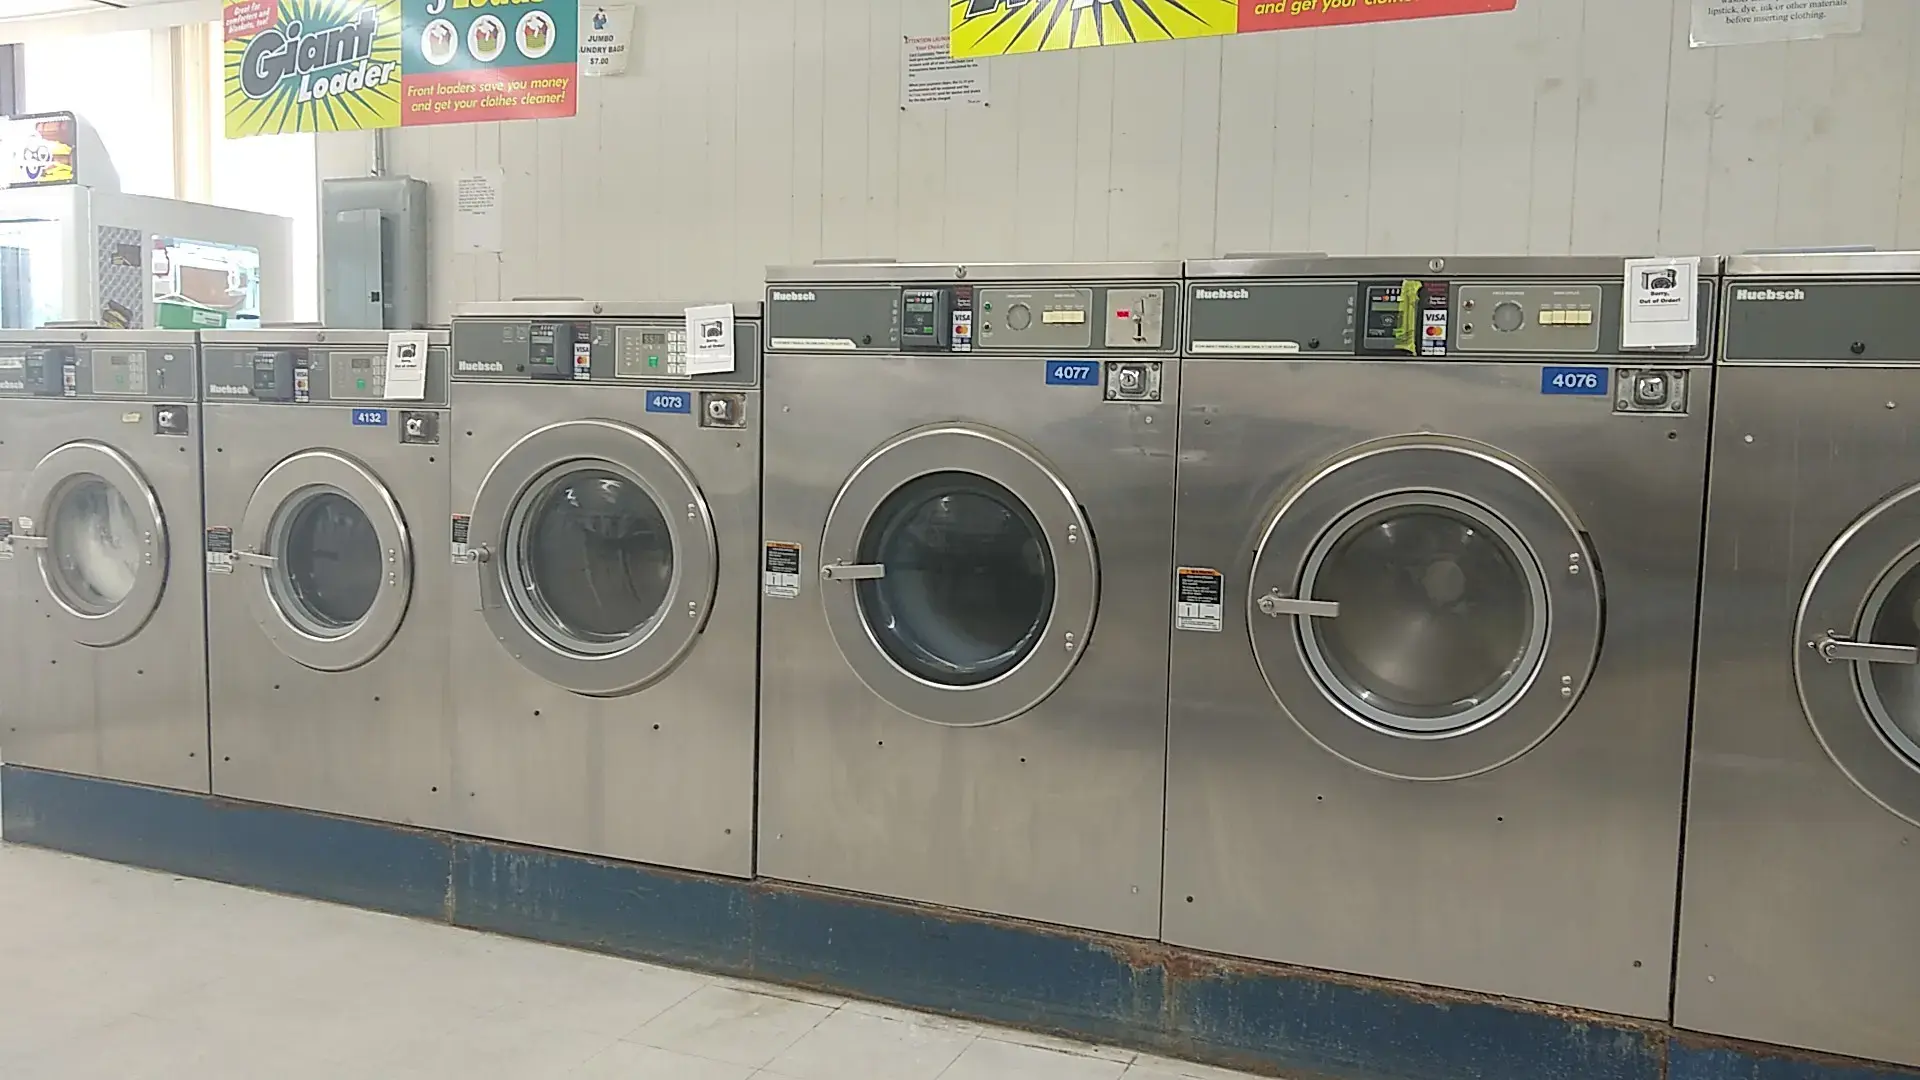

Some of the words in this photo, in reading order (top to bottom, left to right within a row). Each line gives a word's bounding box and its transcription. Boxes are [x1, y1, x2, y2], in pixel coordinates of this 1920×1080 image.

[1254, 0, 1287, 15] and
[1291, 0, 1317, 15] get
[1760, 3, 1773, 12] ink
[1785, 1, 1808, 10] other
[1809, 0, 1847, 8] materials
[1725, 15, 1752, 24] before
[1790, 11, 1827, 20] clothing.
[587, 34, 614, 42] JUMBO
[240, 6, 378, 99] Giant
[608, 45, 625, 53] BAGS
[590, 57, 609, 65] $7.00
[297, 59, 396, 104] Loader
[407, 85, 434, 97] Front
[437, 80, 476, 95] loaders
[479, 81, 504, 93] save
[507, 80, 528, 93] you
[530, 77, 569, 90] money
[411, 98, 432, 112] and
[434, 98, 451, 114] get
[454, 99, 478, 112] your
[480, 94, 518, 108] clothes
[520, 90, 566, 105] cleaner!
[772, 291, 816, 301] Huebsch
[1195, 288, 1249, 300] Huebsch
[1736, 289, 1805, 301] Huebsch
[1425, 313, 1446, 322] VISA
[458, 360, 503, 372] Huebsch
[1054, 366, 1090, 379] 4077
[1552, 373, 1598, 388] 4076
[209, 384, 249, 395] Huebsch
[653, 397, 683, 408] 4073
[358, 412, 381, 423] 4132
